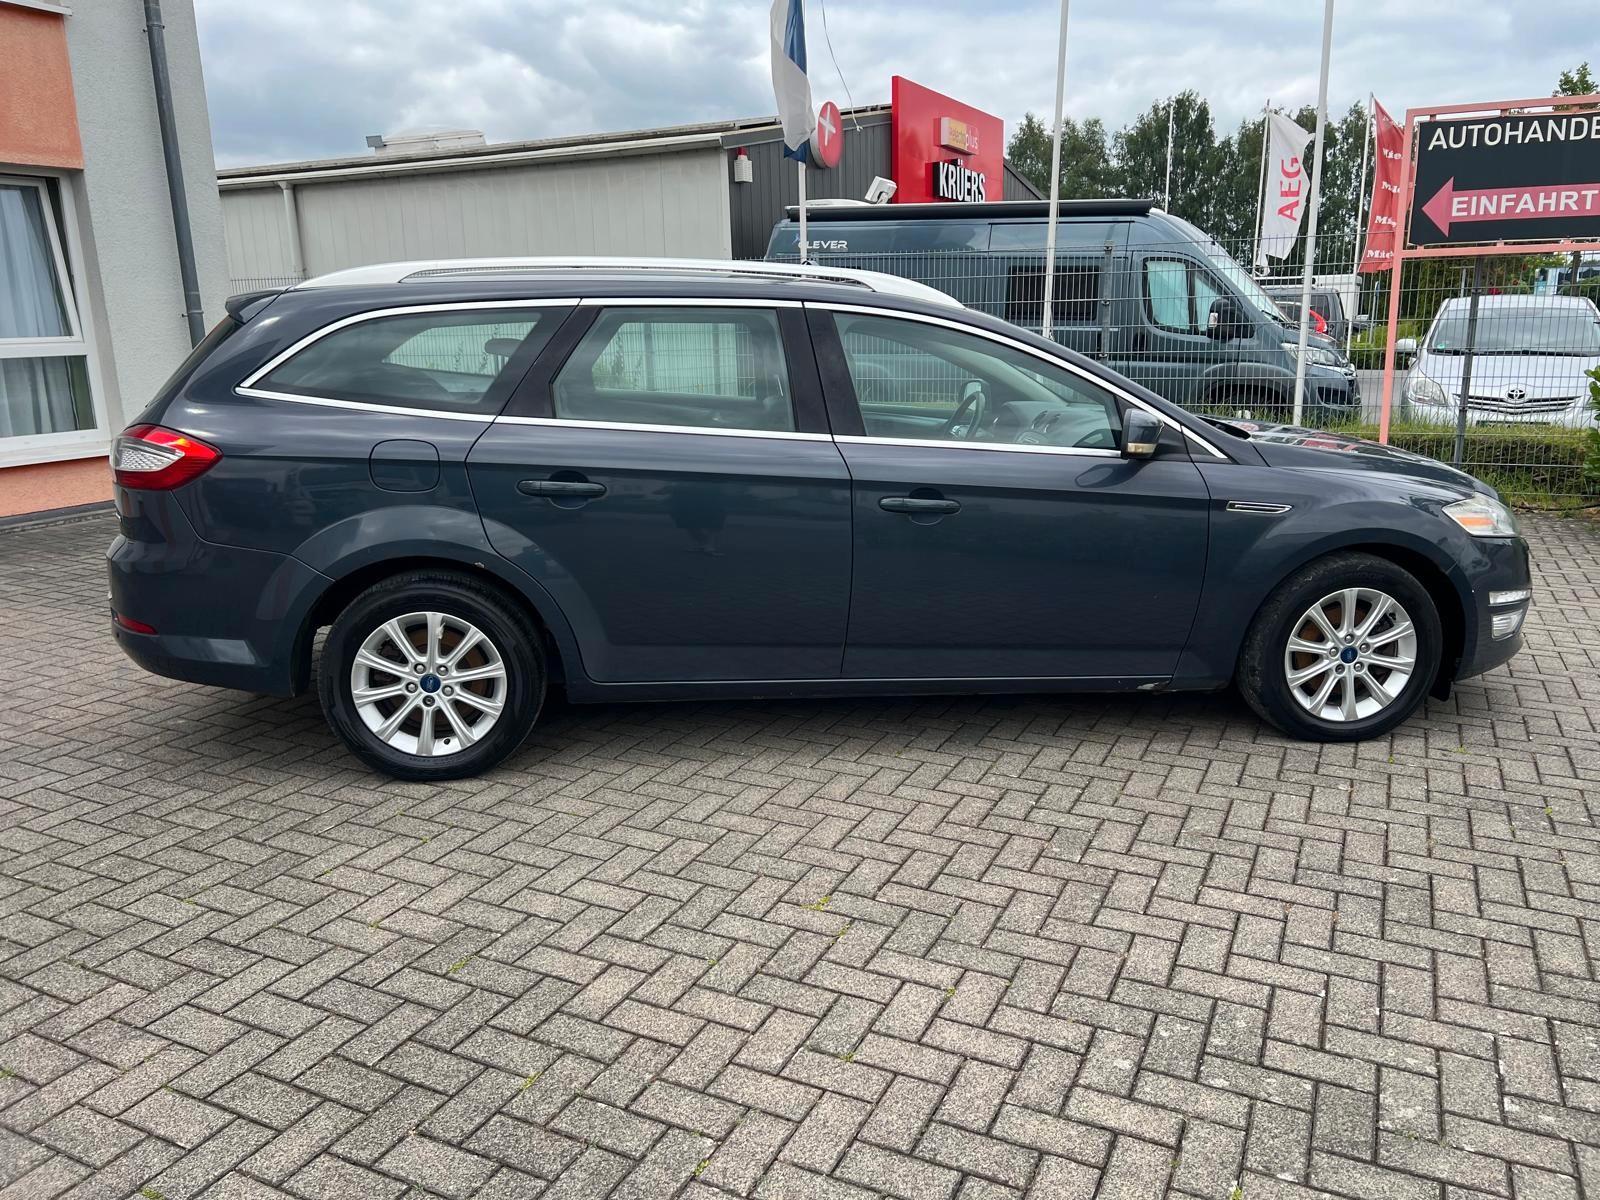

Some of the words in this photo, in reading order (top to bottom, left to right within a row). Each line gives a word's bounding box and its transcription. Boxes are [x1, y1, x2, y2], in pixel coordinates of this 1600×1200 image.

[939, 158, 986, 203] KRÜERS
[1277, 156, 1301, 222] AEG
[1451, 189, 1599, 217] EINFAHRT
